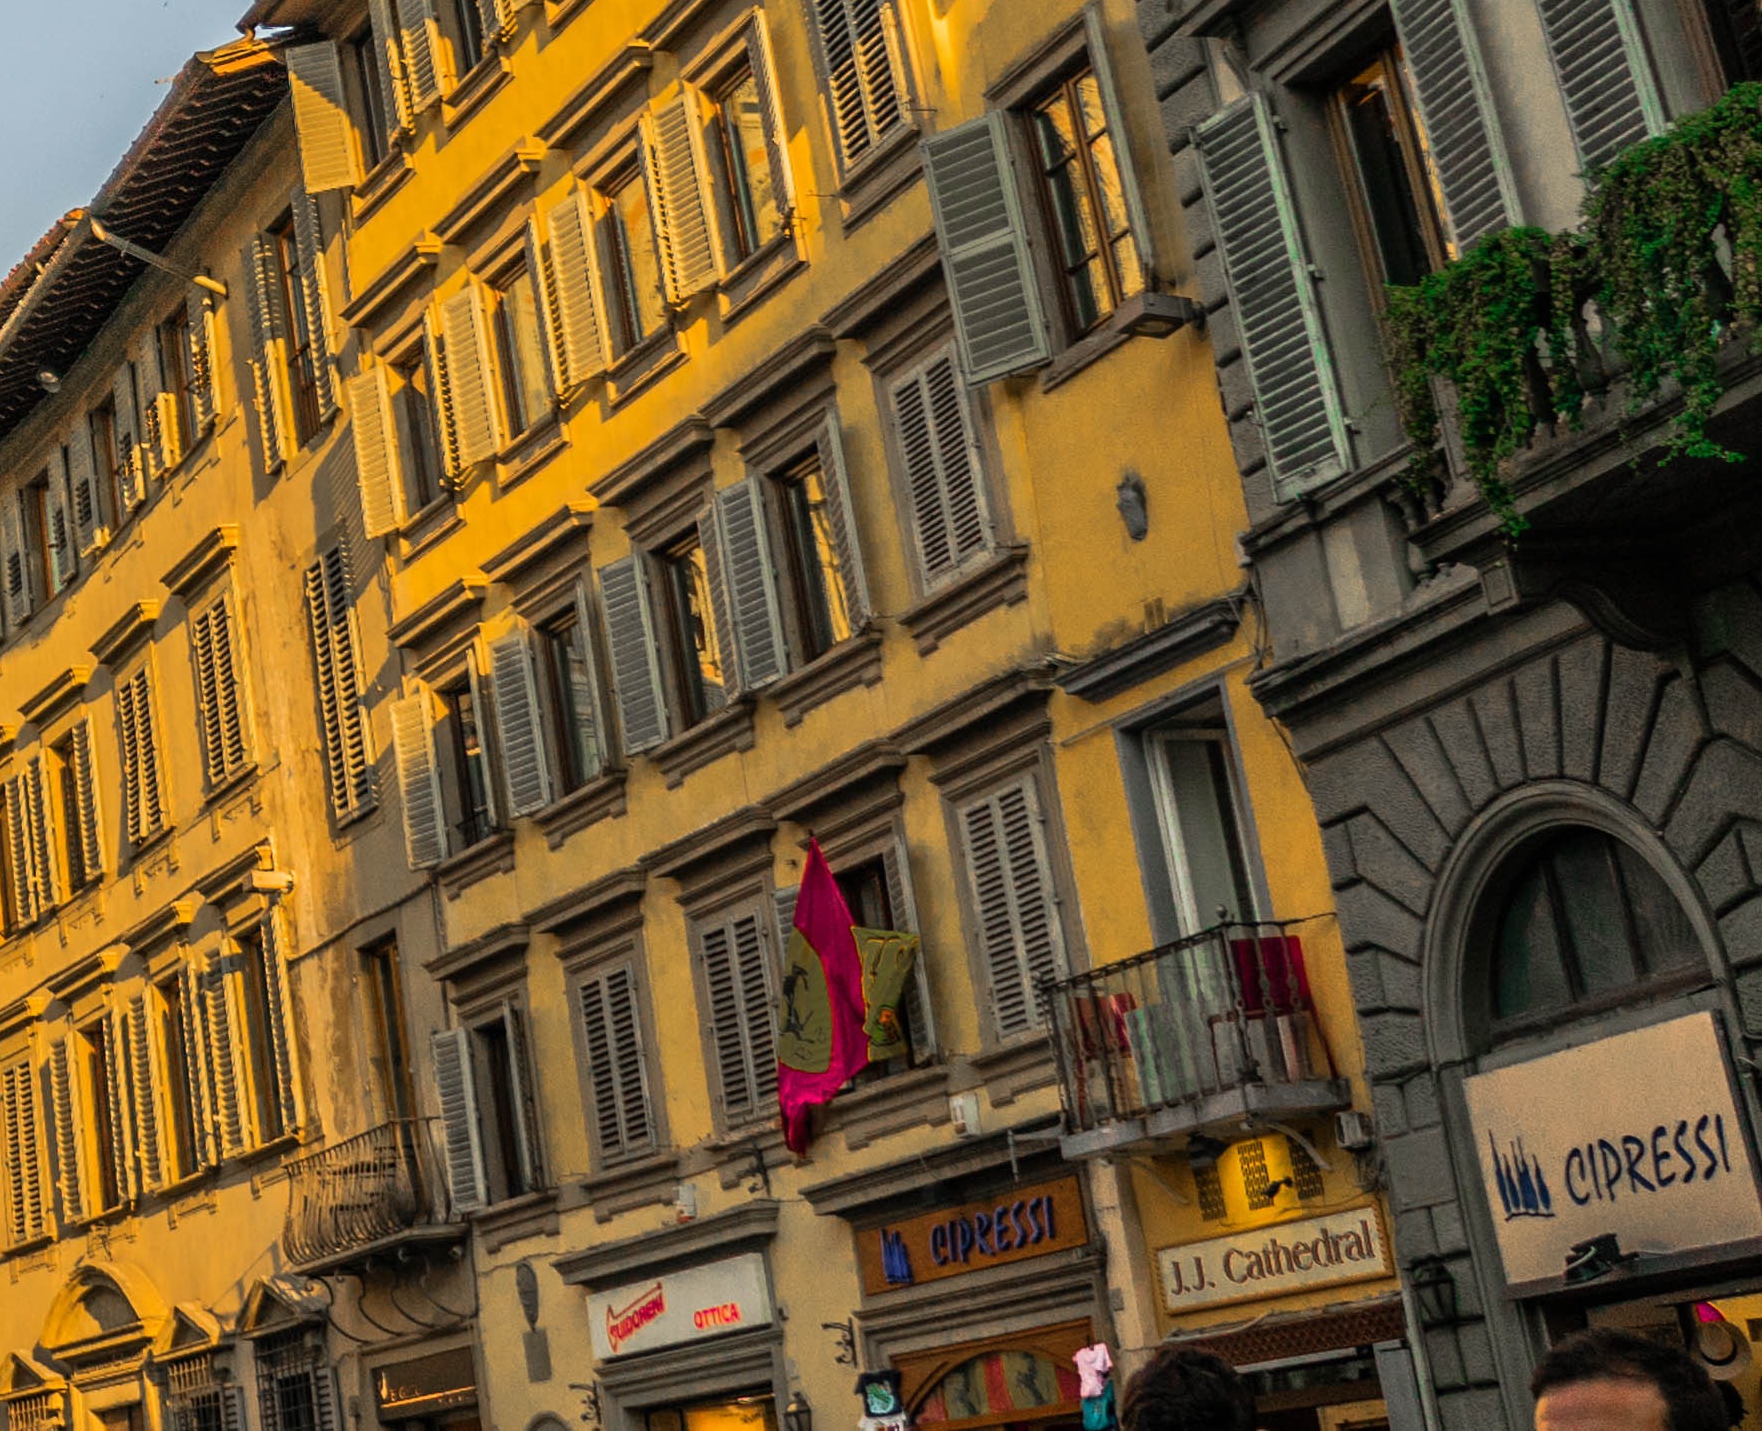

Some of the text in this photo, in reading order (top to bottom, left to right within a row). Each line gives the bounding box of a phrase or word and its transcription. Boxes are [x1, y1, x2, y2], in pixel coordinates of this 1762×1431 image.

[1565, 1113, 1730, 1206] CIPRESSI
[930, 1195, 1056, 1266] CIPRESSI
[1170, 1219, 1376, 1296] J.J. Cathedral
[694, 1303, 741, 1330] OTTICA
